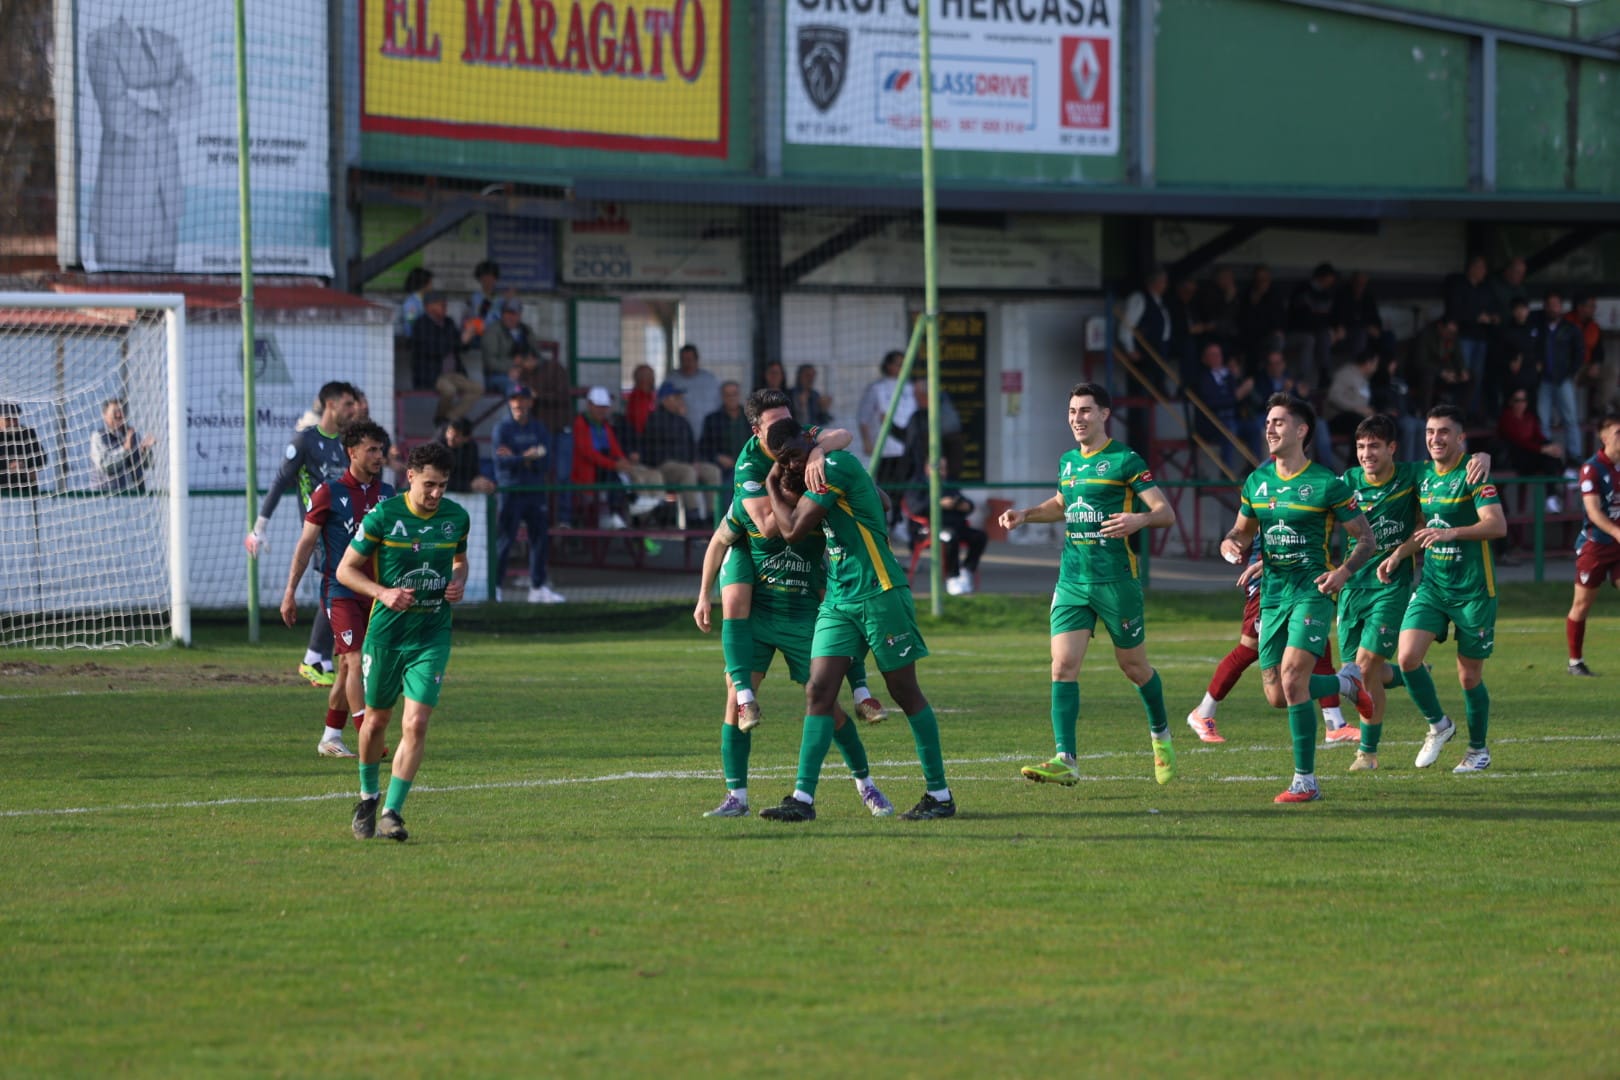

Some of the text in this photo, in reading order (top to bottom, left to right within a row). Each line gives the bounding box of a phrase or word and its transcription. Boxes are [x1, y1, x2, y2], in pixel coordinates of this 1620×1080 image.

[941, 0, 1110, 28] HERCASA
[380, 0, 706, 83] EL MARAGATO
[785, 560, 812, 573] PABLO
